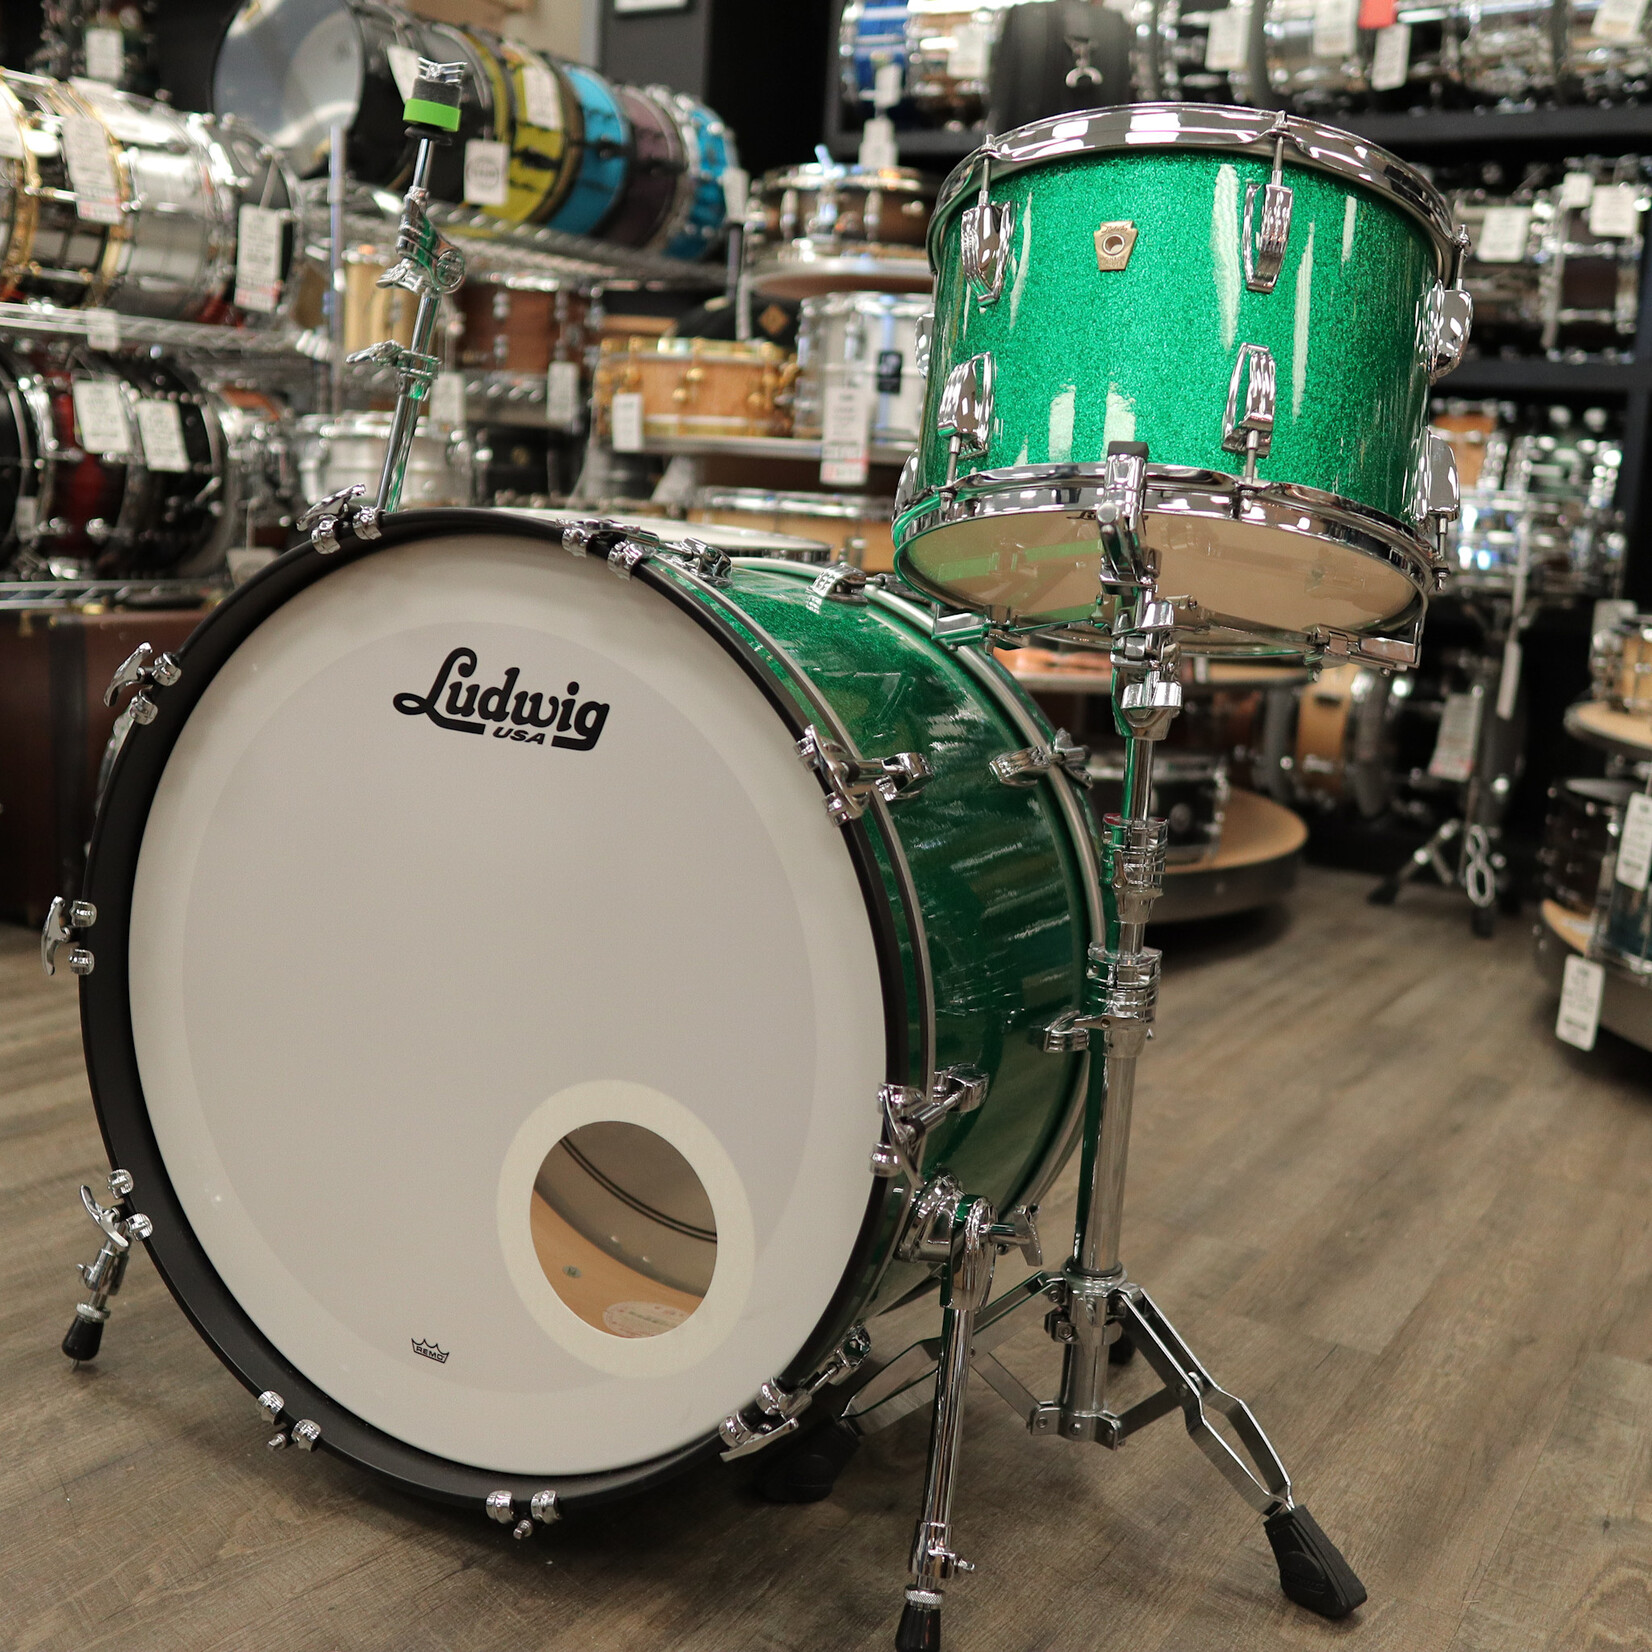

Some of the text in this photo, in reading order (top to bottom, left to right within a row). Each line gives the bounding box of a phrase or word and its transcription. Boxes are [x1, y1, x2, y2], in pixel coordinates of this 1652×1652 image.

[393, 647, 610, 751] Ludwig
[493, 726, 545, 745] USA
[416, 1345, 445, 1361] REMO
